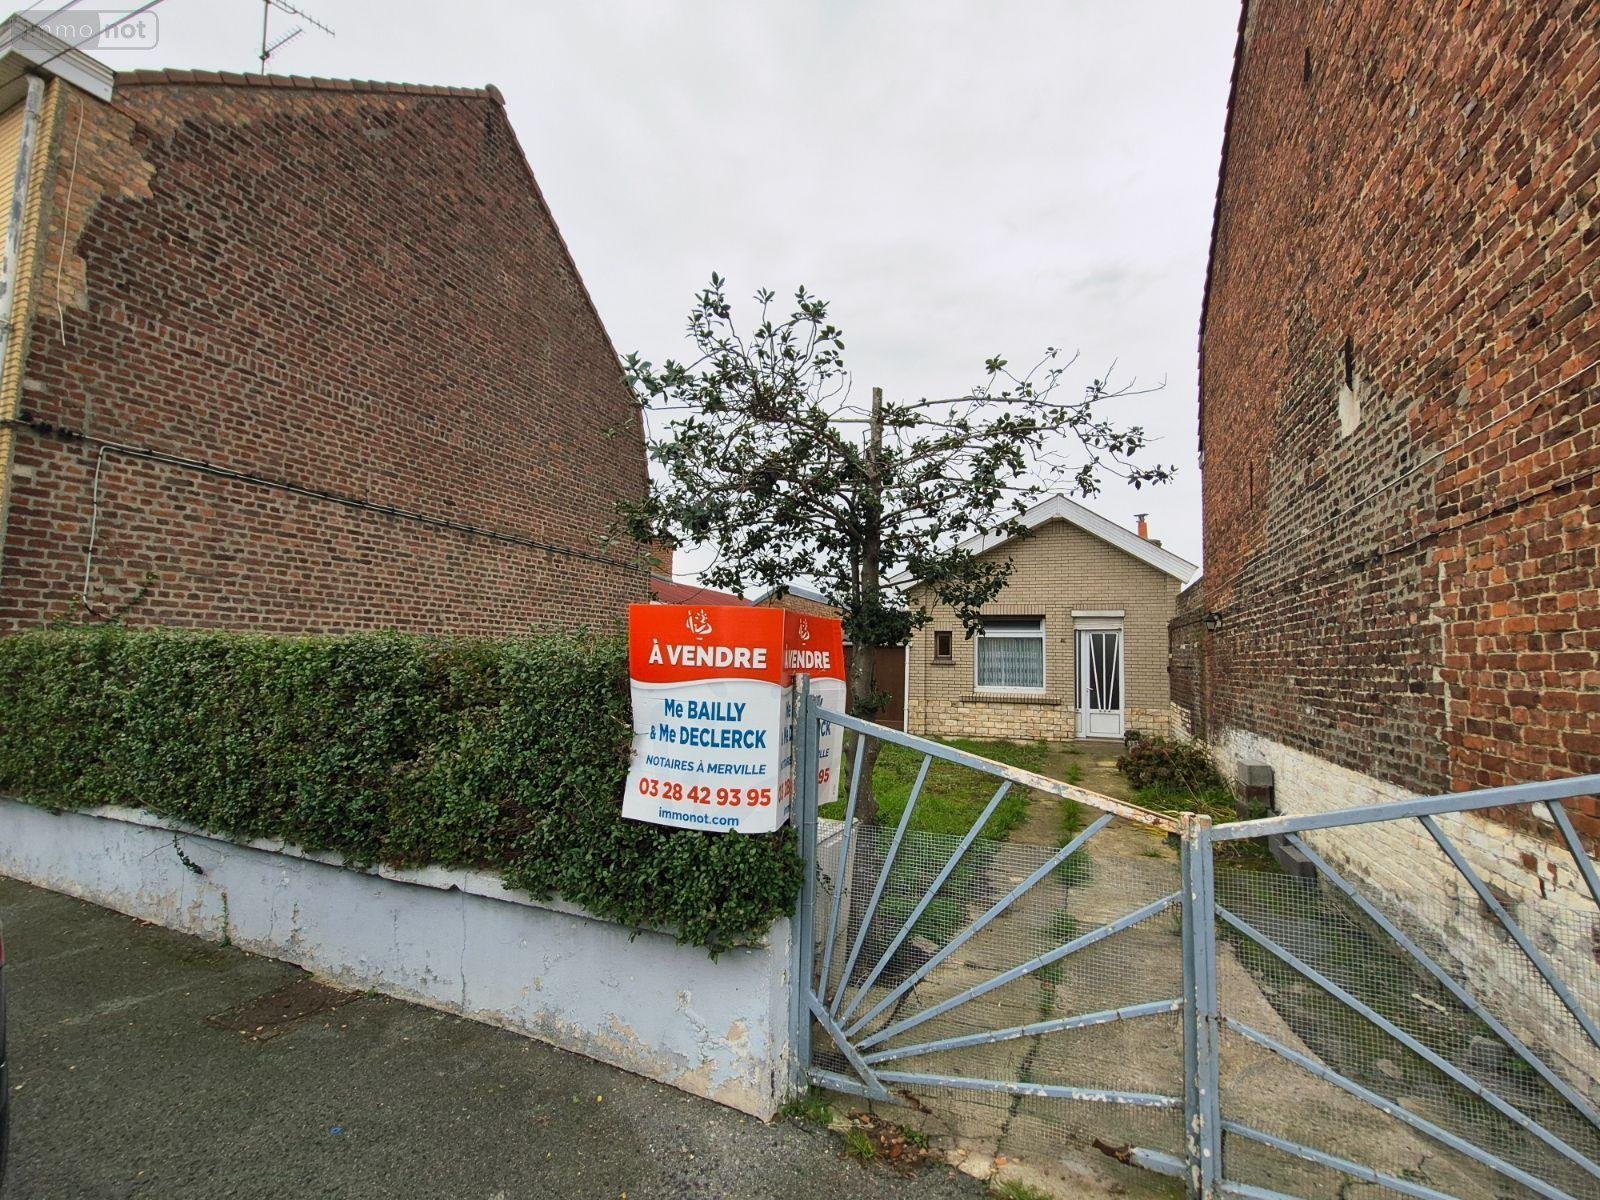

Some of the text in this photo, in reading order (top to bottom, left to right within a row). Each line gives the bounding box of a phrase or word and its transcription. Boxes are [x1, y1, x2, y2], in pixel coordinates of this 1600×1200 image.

[648, 638, 768, 669] À VENDRE
[789, 649, 831, 669] VENDRE
[664, 698, 747, 722] Me BAILLY
[649, 725, 656, 740] &
[659, 723, 676, 743] Me
[679, 726, 767, 749] DECLERCK
[645, 755, 767, 775] NOTAIRES À MERVILLE
[639, 777, 771, 807] 03 28 42 93 95
[658, 806, 739, 827] immonot.com
